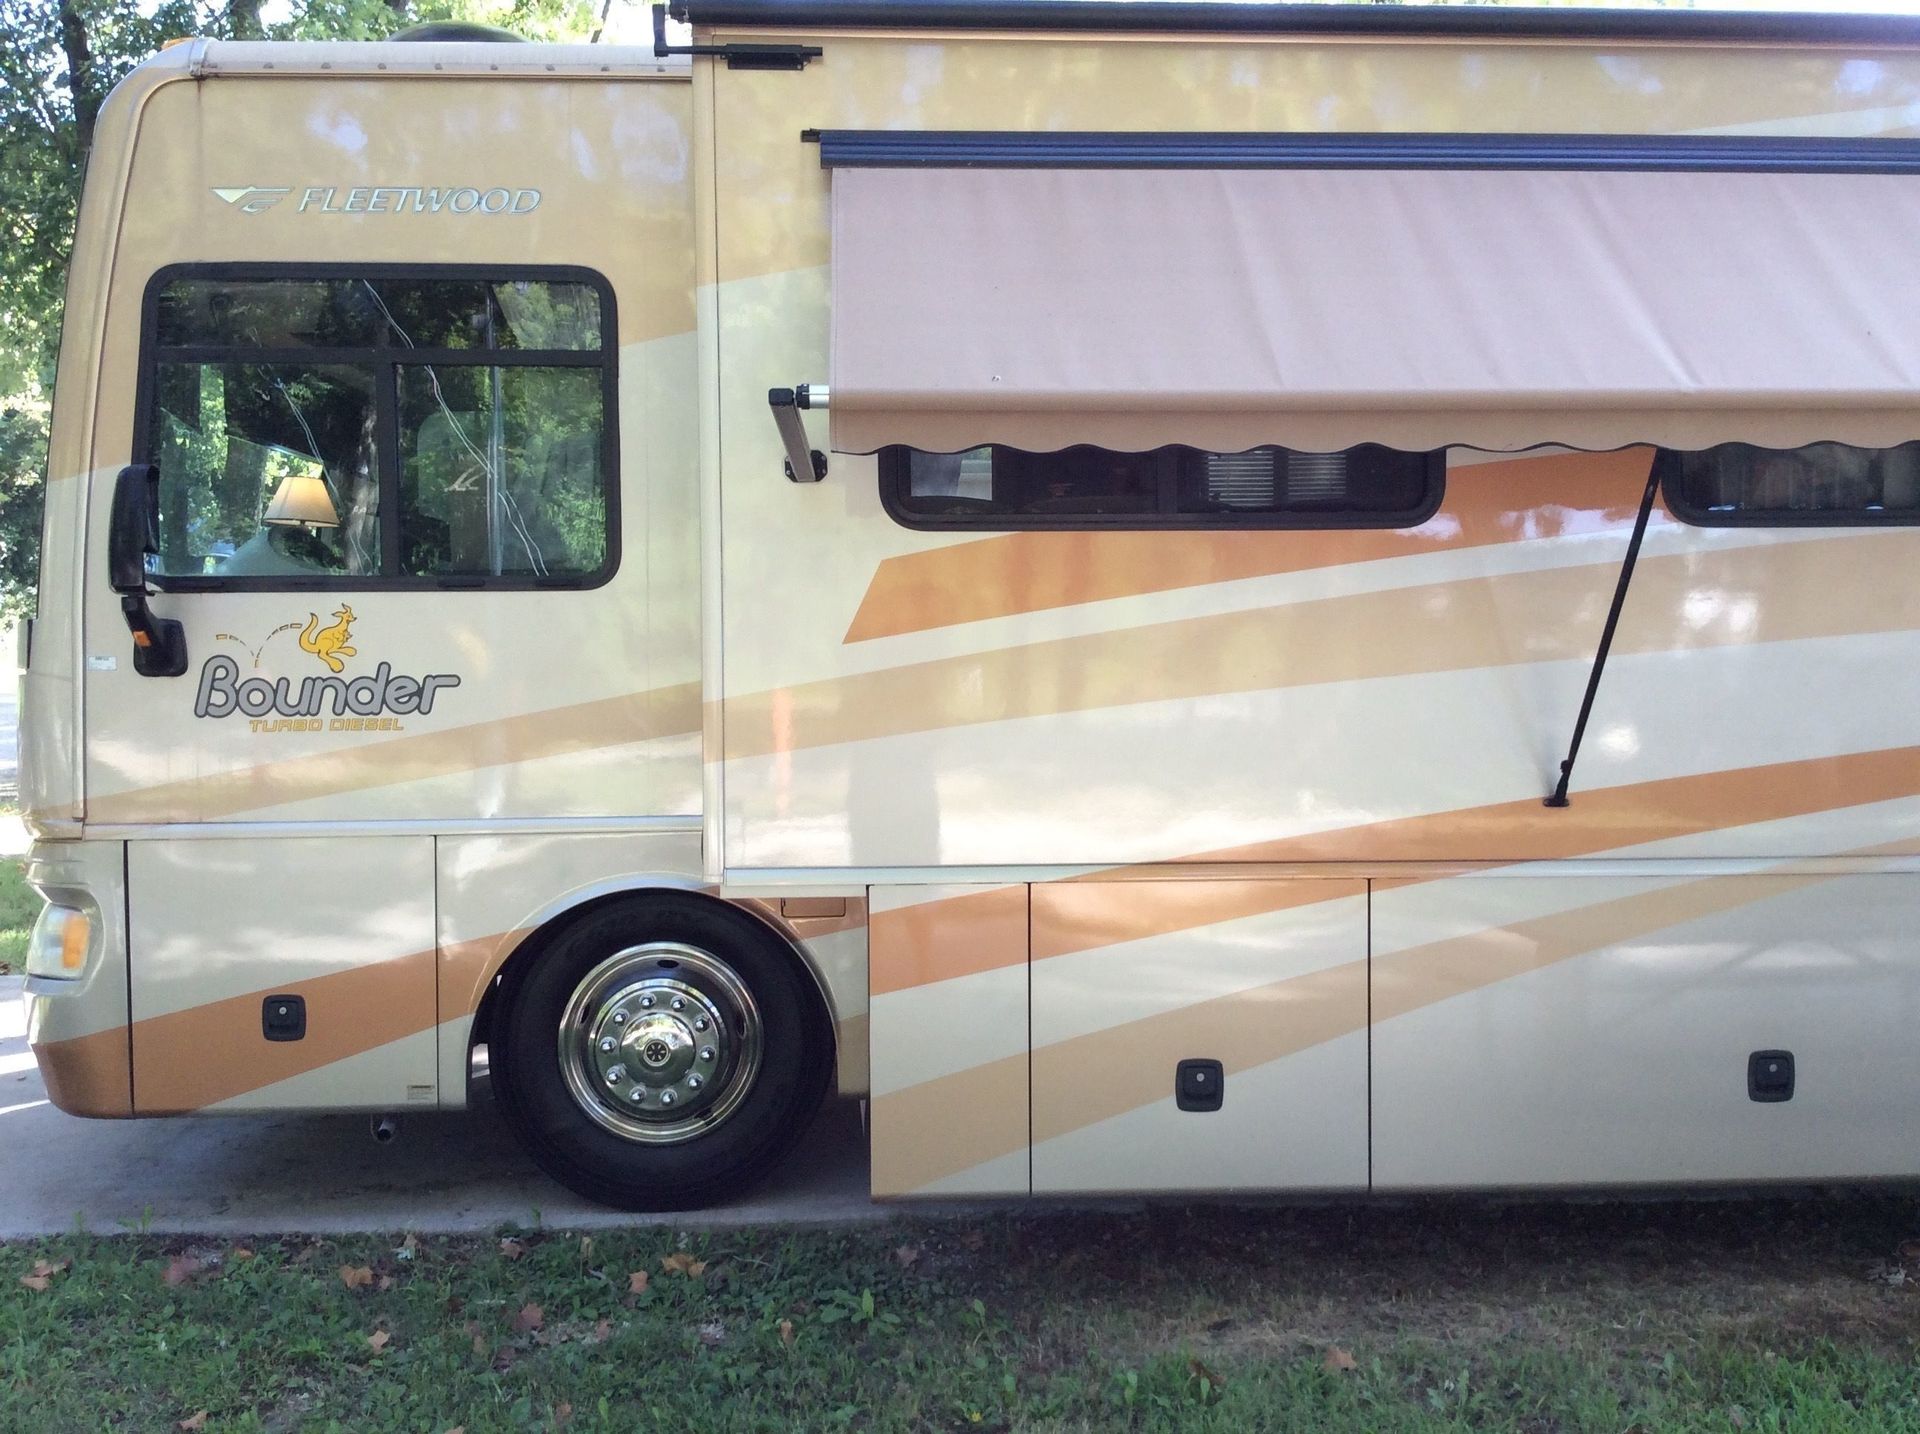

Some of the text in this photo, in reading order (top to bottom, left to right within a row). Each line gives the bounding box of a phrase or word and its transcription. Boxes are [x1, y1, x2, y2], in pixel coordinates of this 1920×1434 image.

[298, 187, 543, 214] FLEETWOOD
[194, 654, 461, 718] Bounder
[249, 717, 404, 733] TURBO DIESEL
